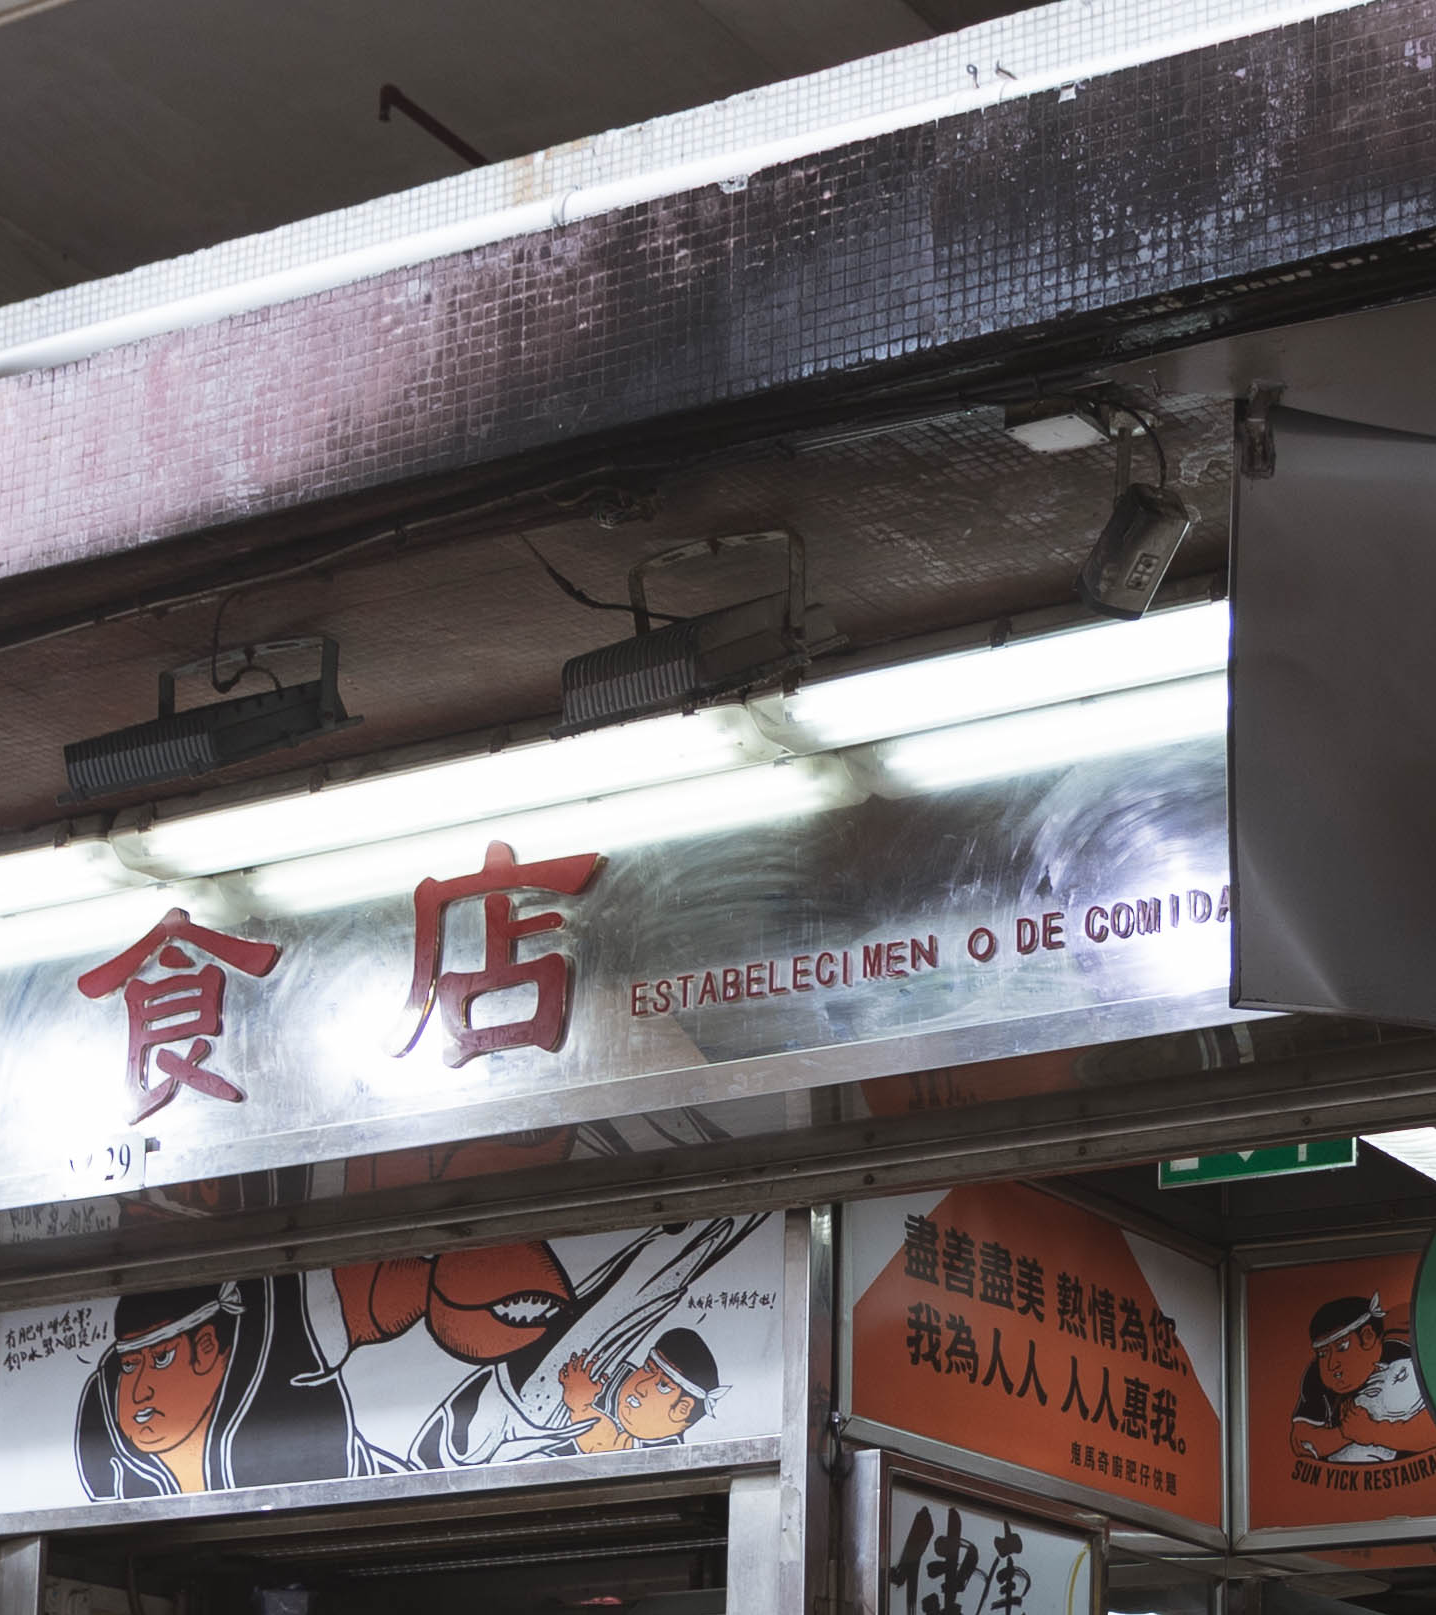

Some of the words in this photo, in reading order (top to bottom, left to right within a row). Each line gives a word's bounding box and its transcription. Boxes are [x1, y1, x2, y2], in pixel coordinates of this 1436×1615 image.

[1017, 912, 1065, 955] DE
[903, 1213, 1046, 1323] 盡善盡美
[906, 1302, 1048, 1407] 我為人人
[1291, 1459, 1323, 1487] SUN
[1326, 1468, 1359, 1491] YICK
